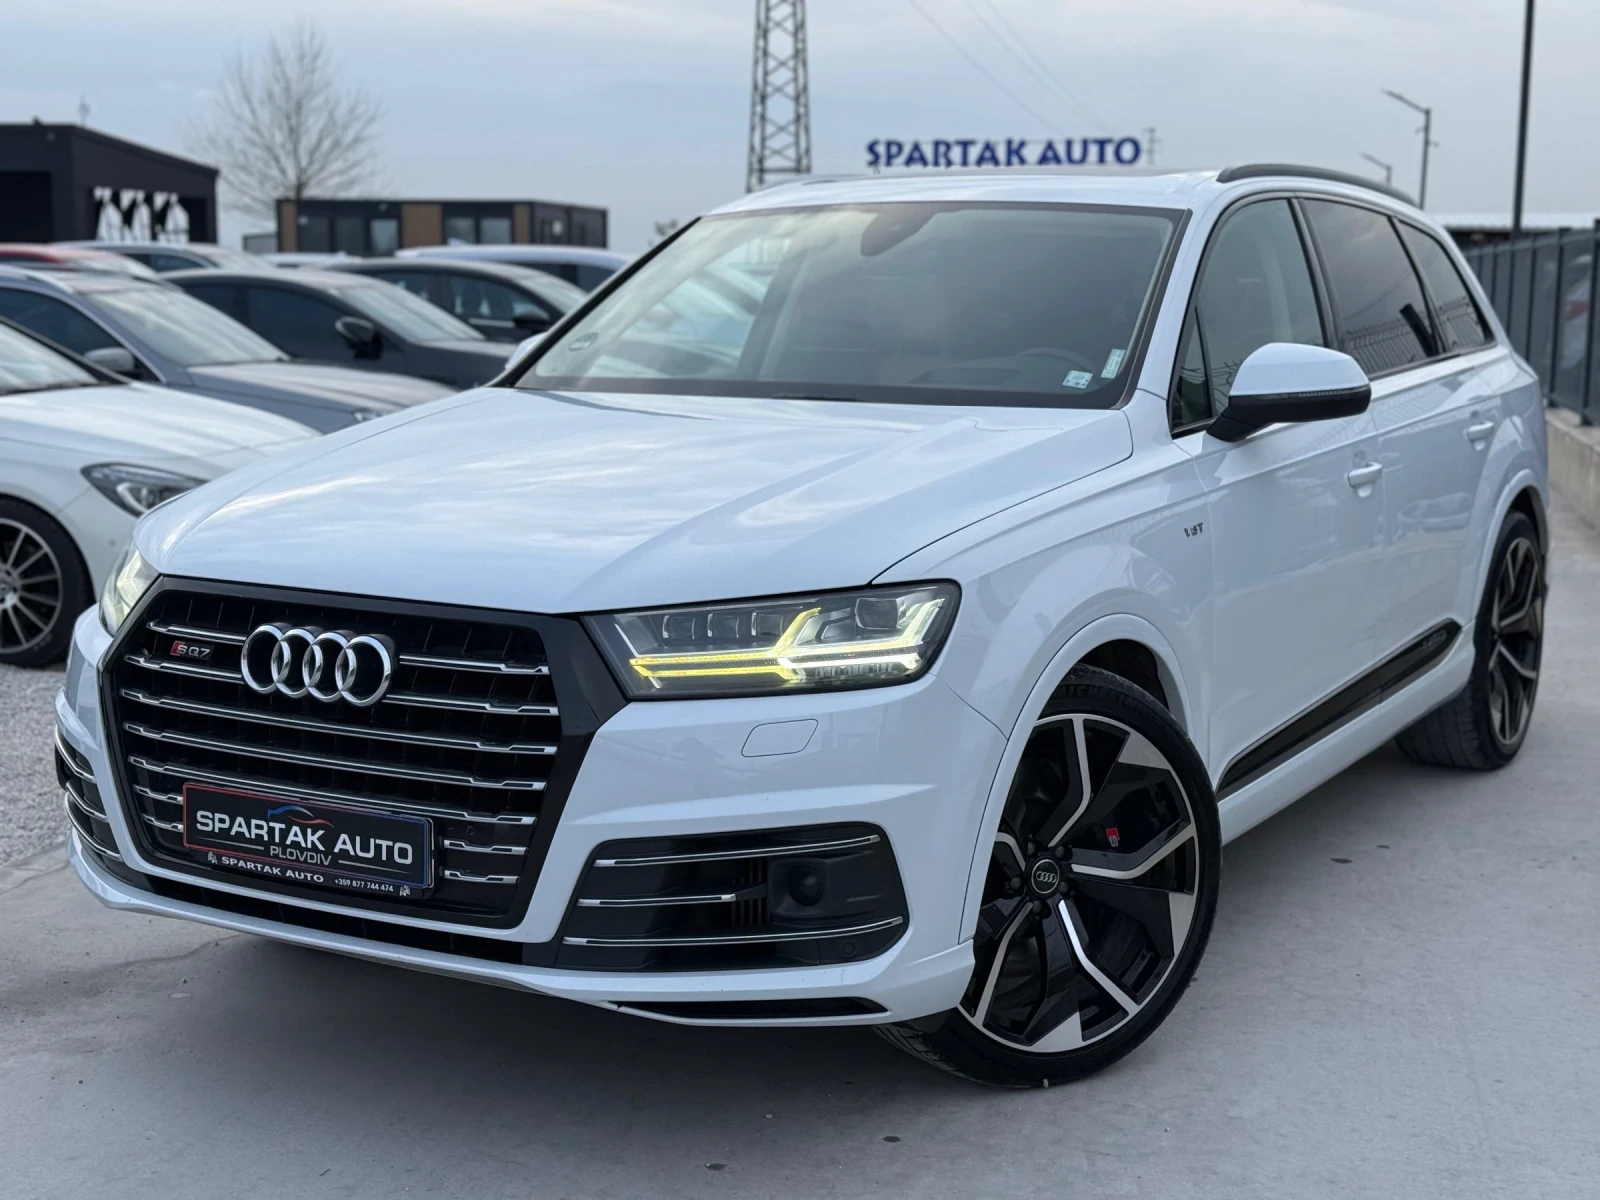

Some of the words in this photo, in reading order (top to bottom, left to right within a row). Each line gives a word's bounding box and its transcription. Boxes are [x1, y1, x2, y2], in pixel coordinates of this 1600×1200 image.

[866, 138, 1027, 169] SPARTAK
[1037, 136, 1142, 166] AUTO
[177, 644, 210, 658] SQ7
[196, 810, 325, 851] SPARTAK
[333, 833, 413, 865] AUTO
[269, 845, 332, 866] PLOVDIV
[221, 856, 282, 875] SPARTAK
[285, 869, 324, 883] AUTO
[334, 878, 351, 886] +359
[366, 882, 379, 890] 744
[380, 884, 394, 892] 474
